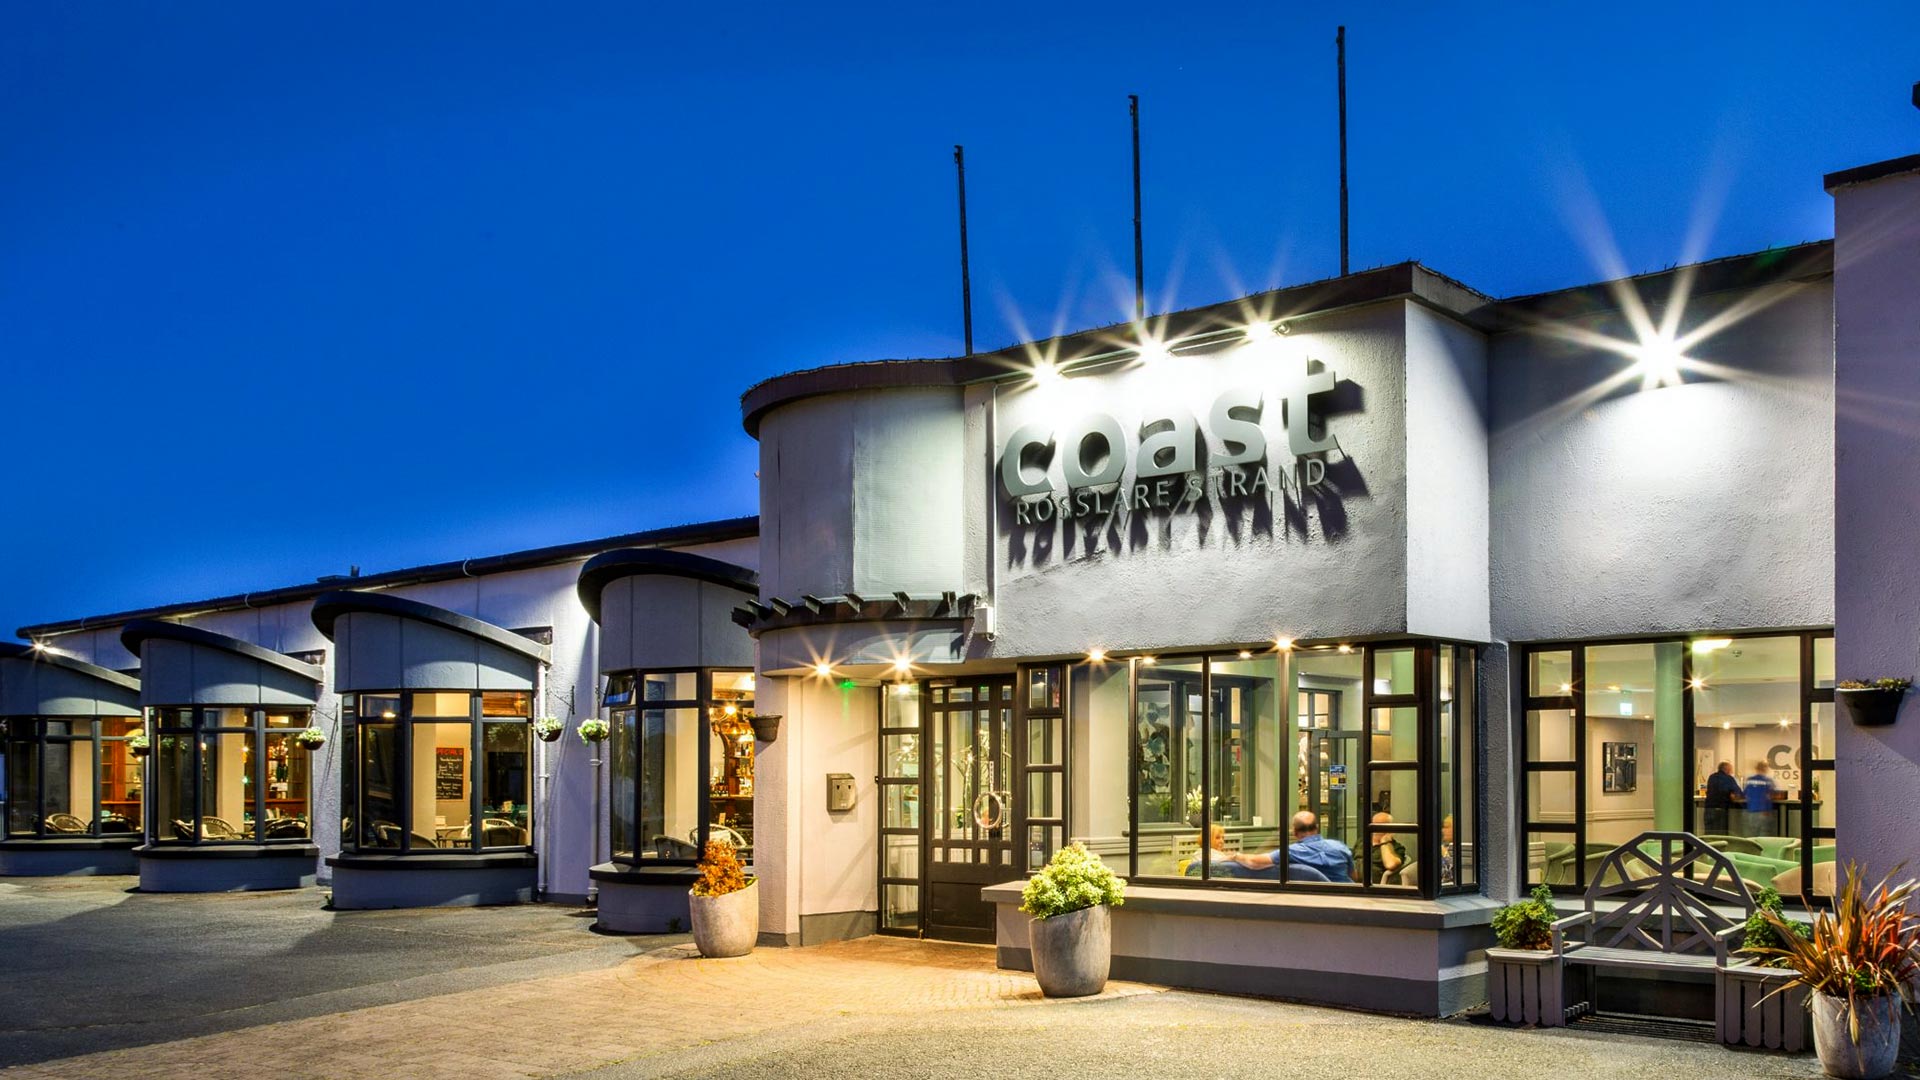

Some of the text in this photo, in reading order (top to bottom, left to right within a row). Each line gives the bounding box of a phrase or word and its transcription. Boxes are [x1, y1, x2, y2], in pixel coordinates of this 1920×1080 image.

[1002, 355, 1338, 496] coast
[1016, 458, 1325, 525] ROSSLARE STRAND
